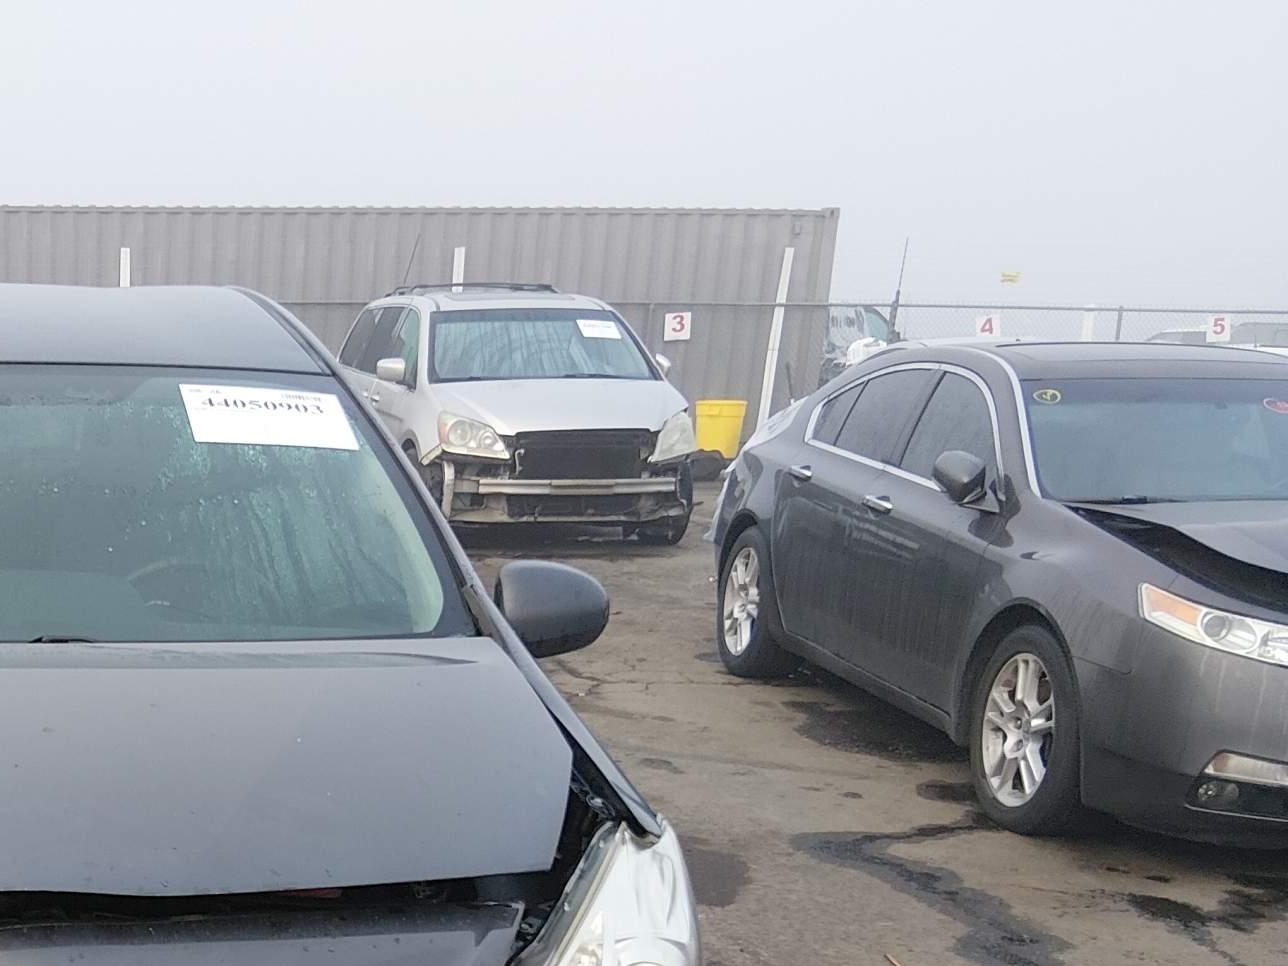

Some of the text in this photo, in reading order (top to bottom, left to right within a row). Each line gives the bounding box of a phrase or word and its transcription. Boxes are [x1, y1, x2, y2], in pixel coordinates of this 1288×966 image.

[671, 314, 686, 333] 3
[980, 316, 994, 335] 4
[1212, 317, 1226, 335] 5
[201, 396, 325, 415] 44050903
